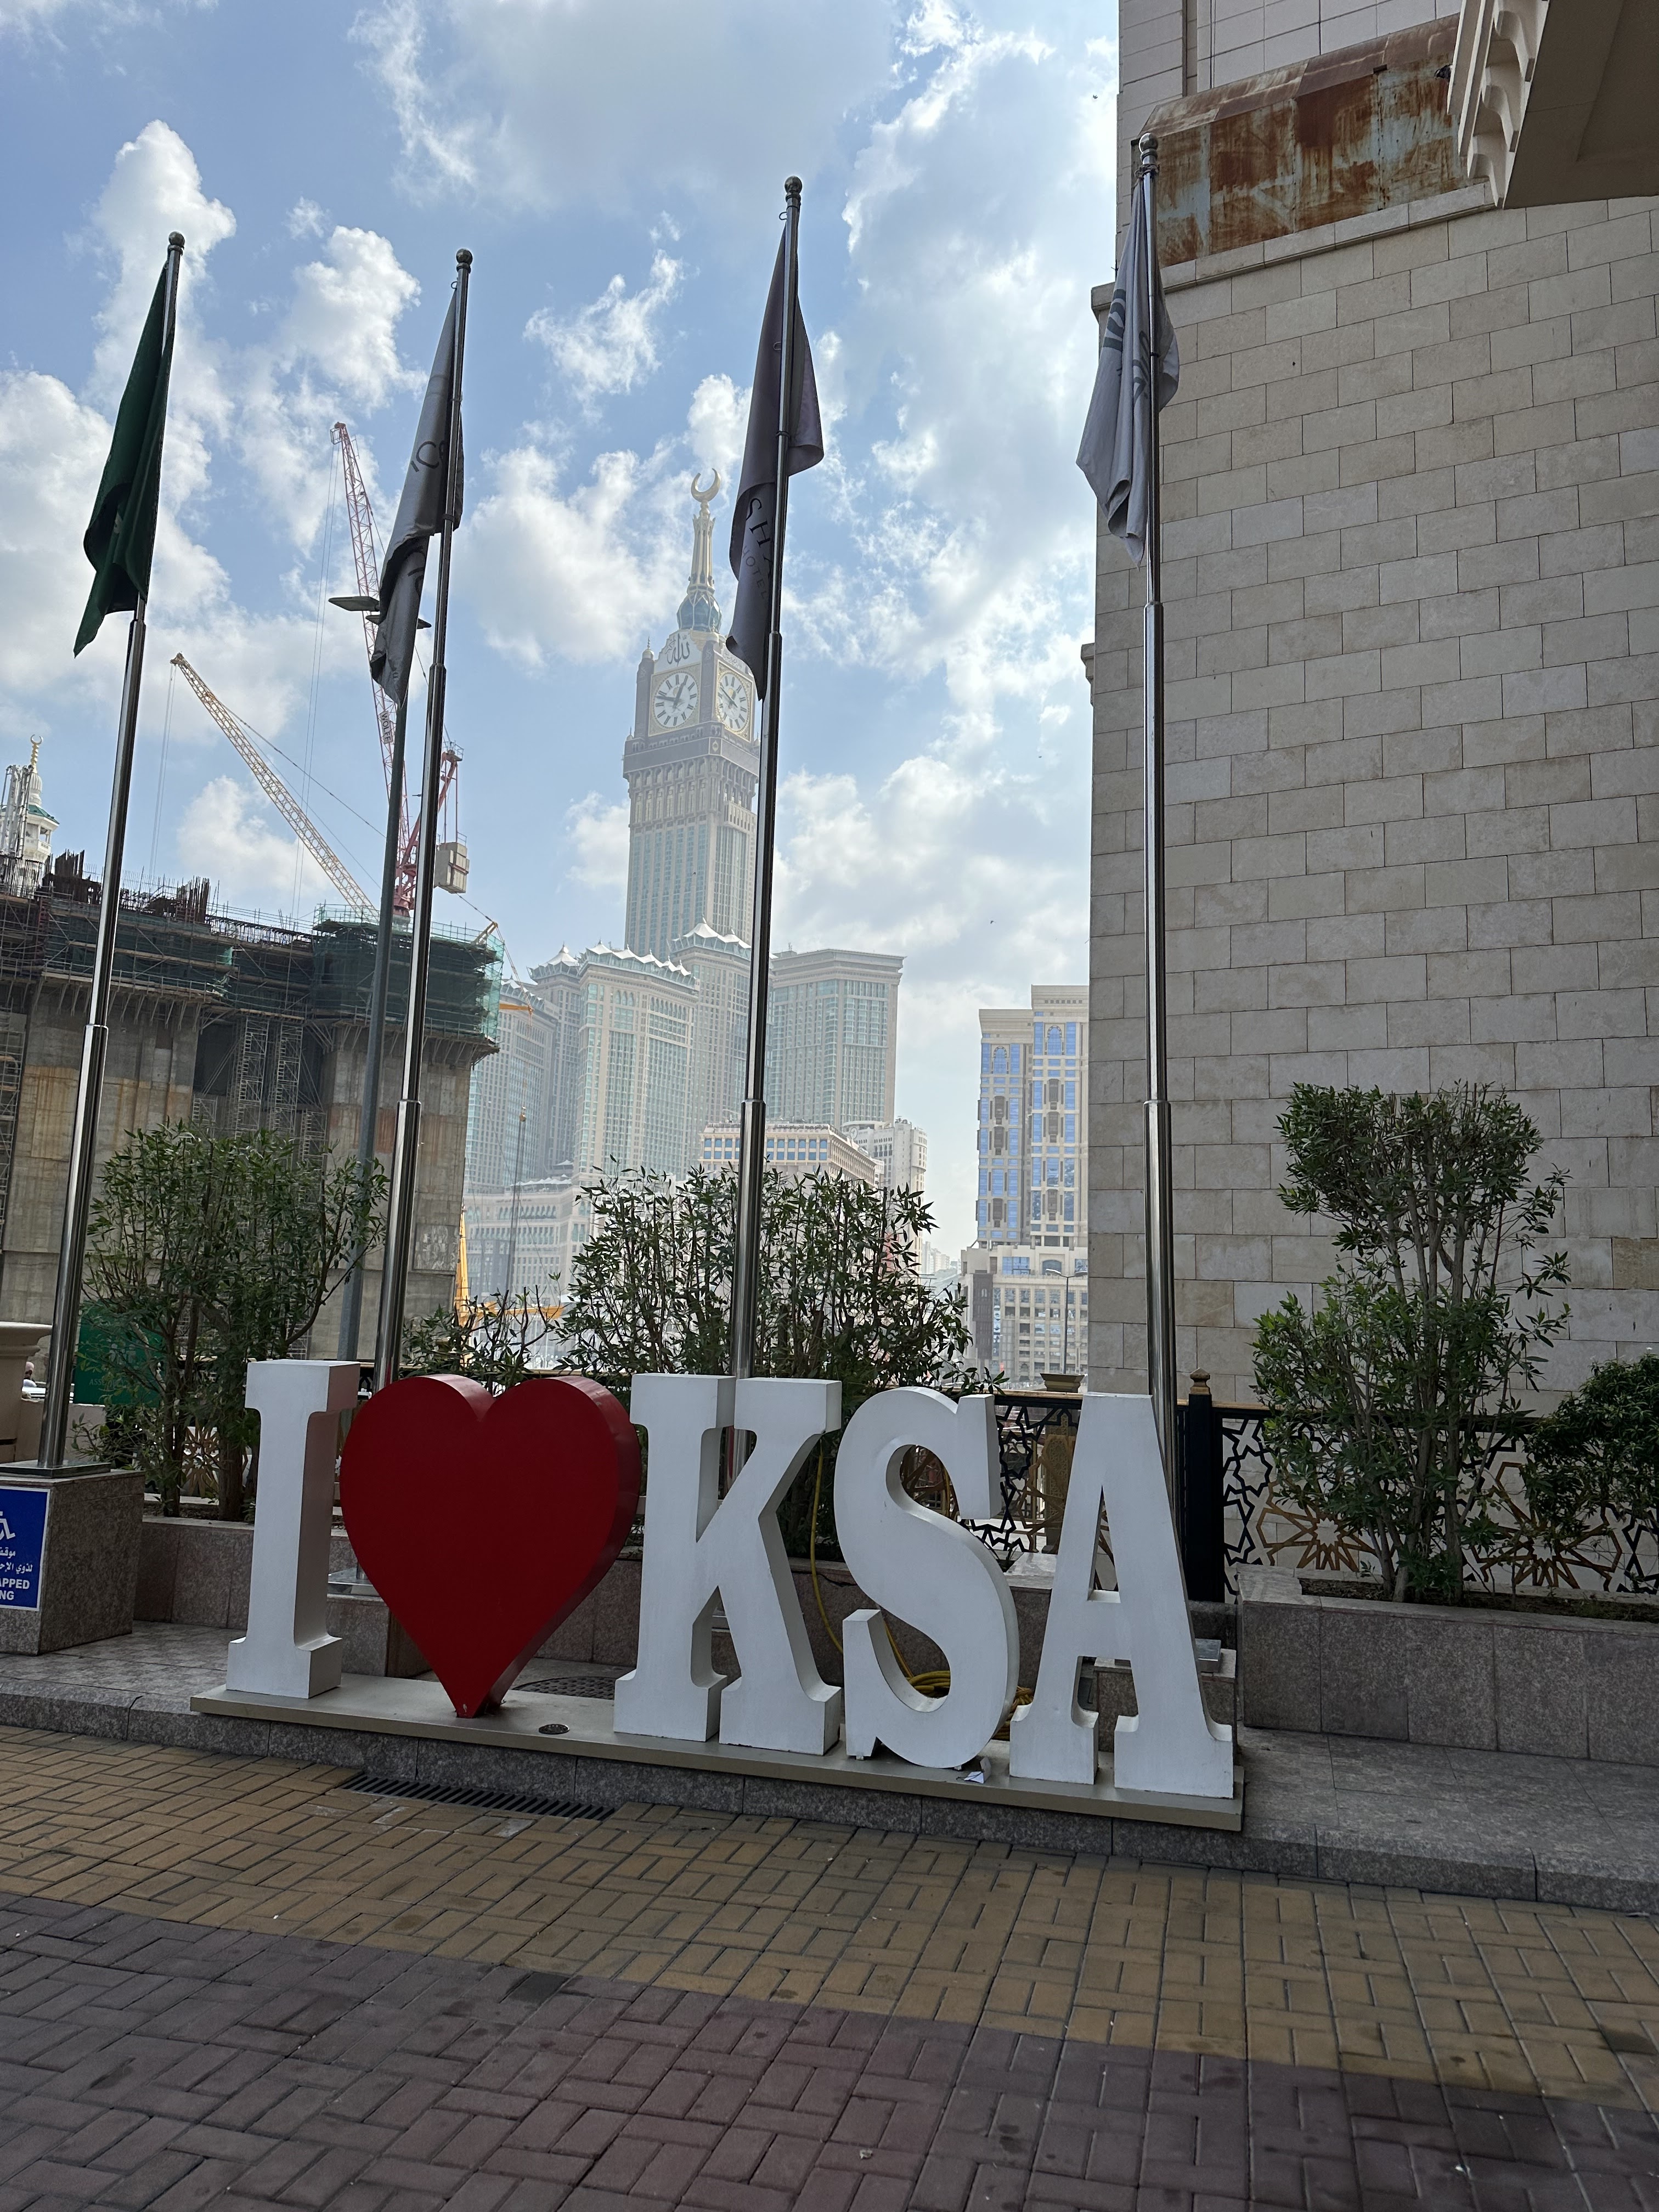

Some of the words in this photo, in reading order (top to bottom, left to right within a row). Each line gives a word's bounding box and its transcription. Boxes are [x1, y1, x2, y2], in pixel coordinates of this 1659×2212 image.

[381, 713, 391, 741] WOLFF
[16, 1563, 33, 1575] لذوي
[226, 1359, 359, 1700] I
[613, 1373, 1234, 1799] KSA
